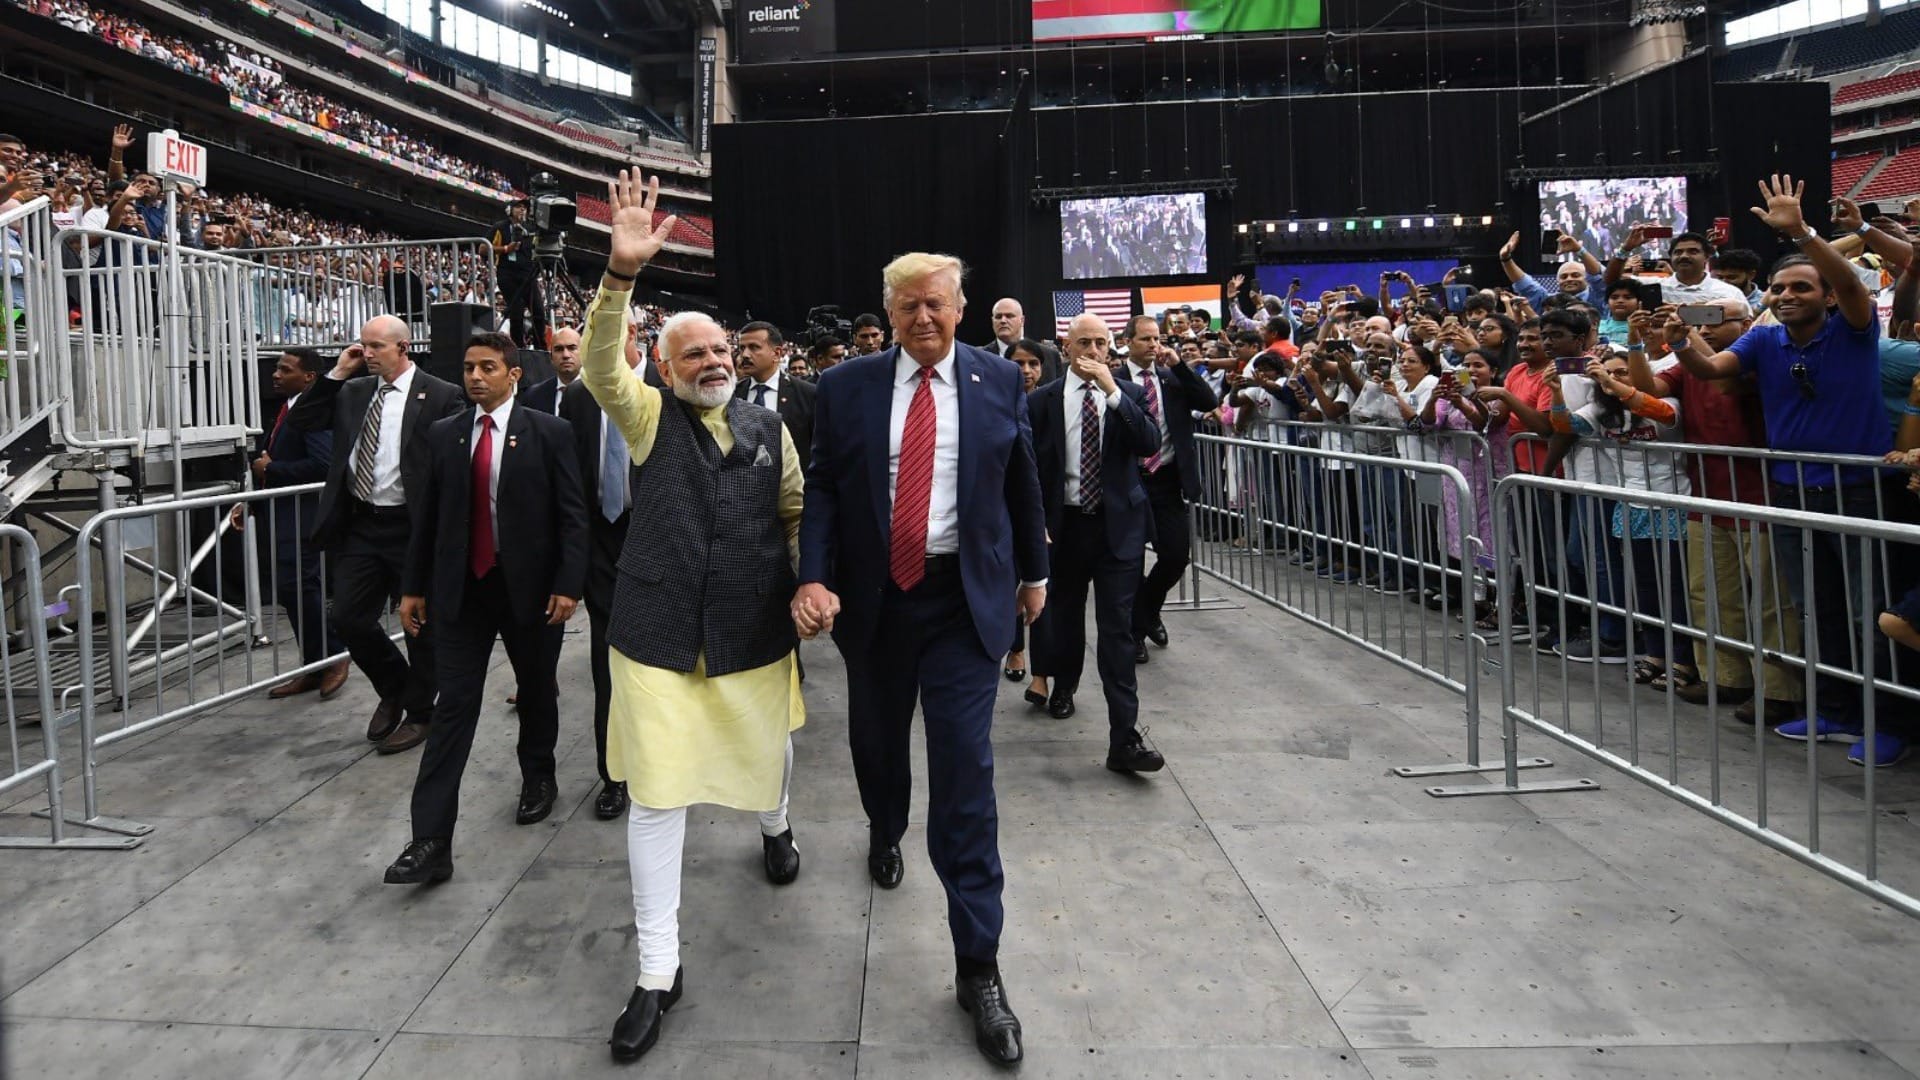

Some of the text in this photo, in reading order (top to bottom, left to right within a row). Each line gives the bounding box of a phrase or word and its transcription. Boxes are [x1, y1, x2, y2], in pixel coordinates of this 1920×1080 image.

[748, 5, 801, 21] reliant
[700, 54, 715, 62] TEXT
[166, 137, 200, 177] EXIT
